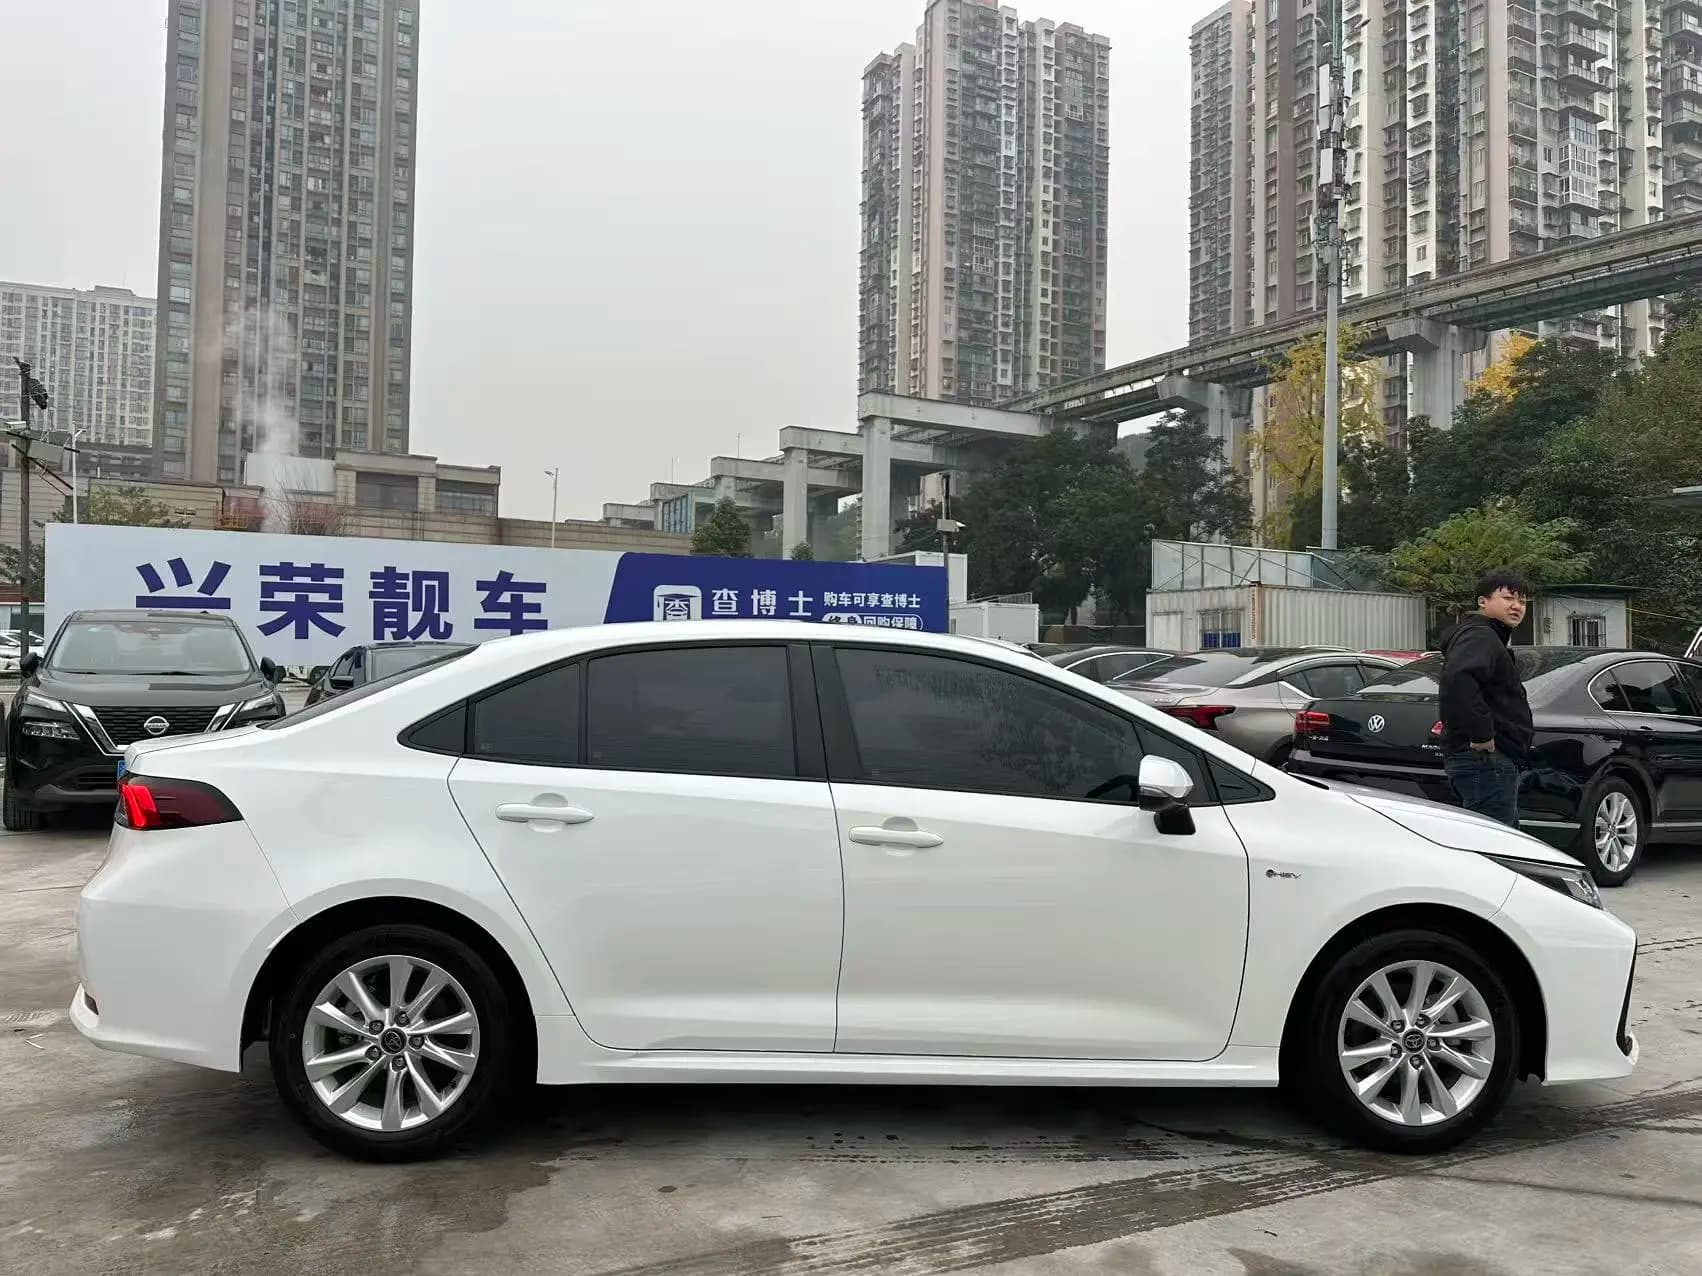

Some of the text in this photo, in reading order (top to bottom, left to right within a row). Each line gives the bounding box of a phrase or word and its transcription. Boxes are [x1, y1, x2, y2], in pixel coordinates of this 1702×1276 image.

[136, 557, 548, 641] 兴荣靓车
[711, 588, 813, 616] 查博士
[823, 591, 920, 609] 购车可享查博士
